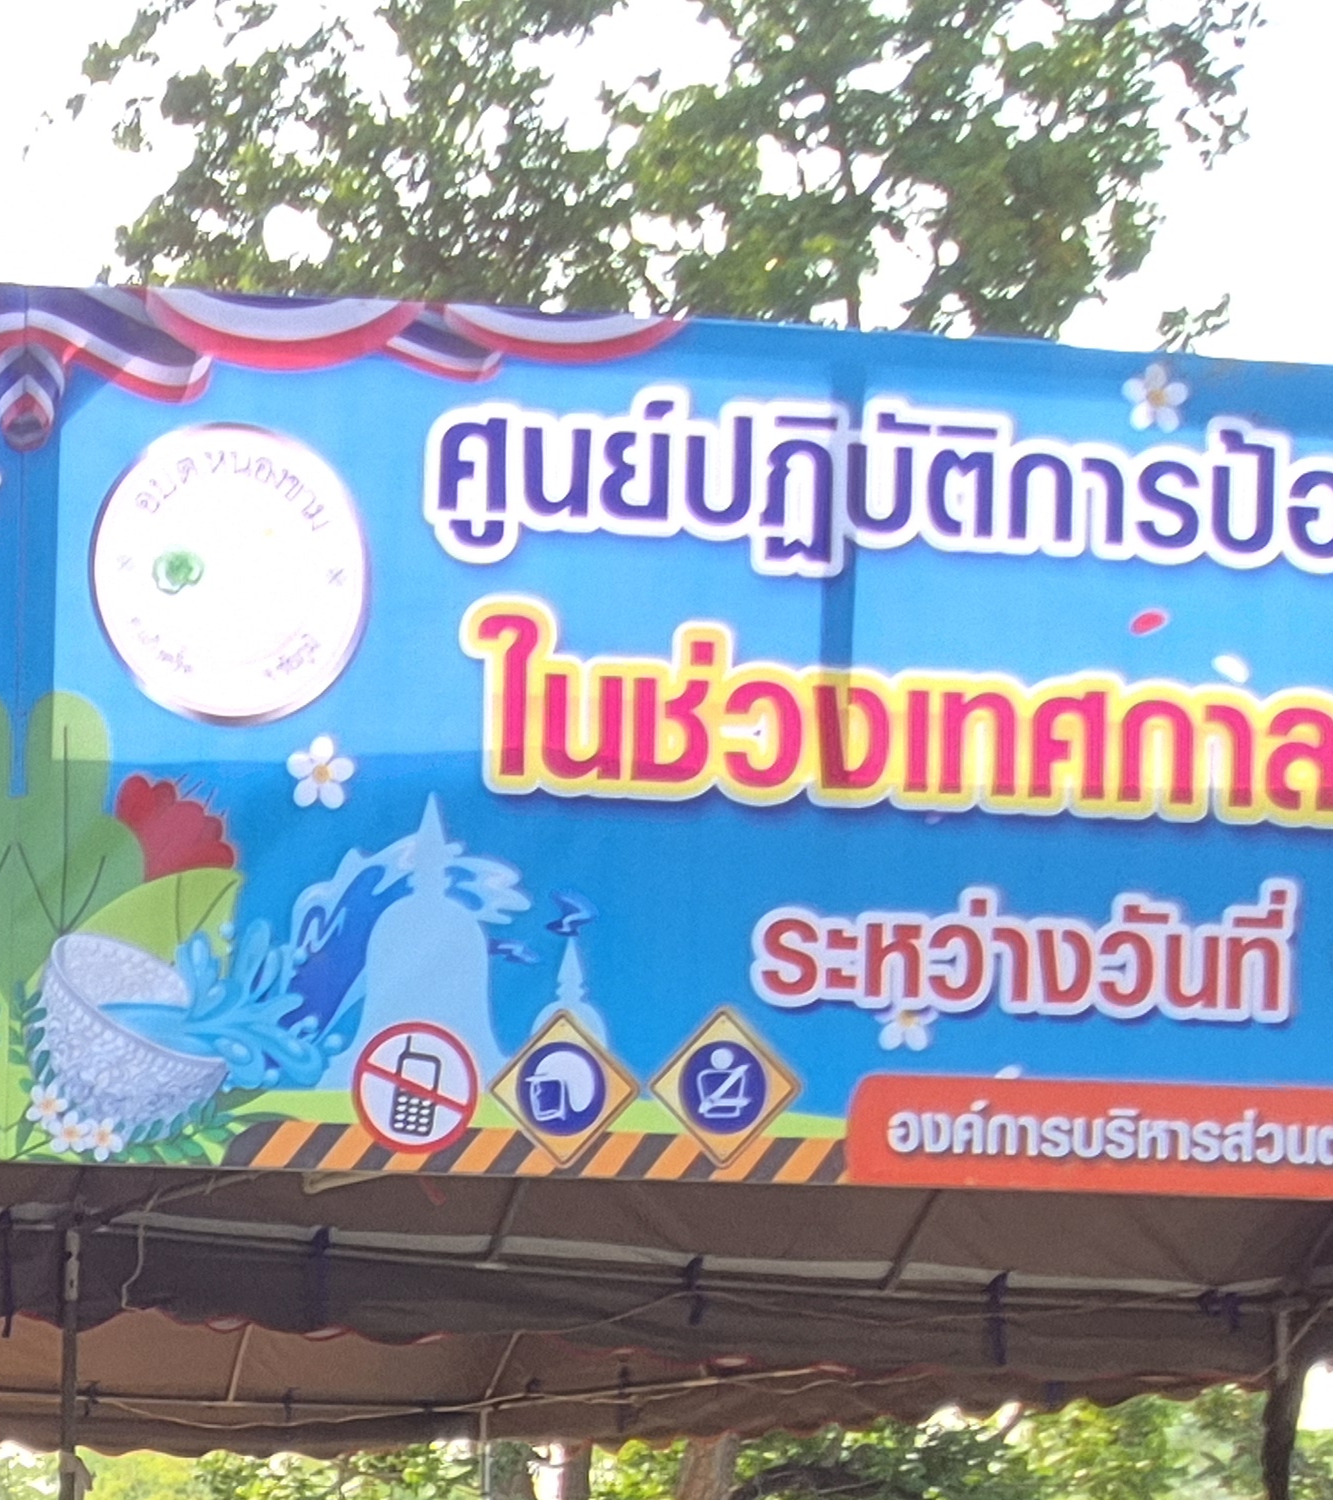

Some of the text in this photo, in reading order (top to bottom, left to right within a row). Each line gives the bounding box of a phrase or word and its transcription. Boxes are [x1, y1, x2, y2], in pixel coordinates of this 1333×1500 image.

[761, 889, 1287, 1013] ระหว่างวันที่
